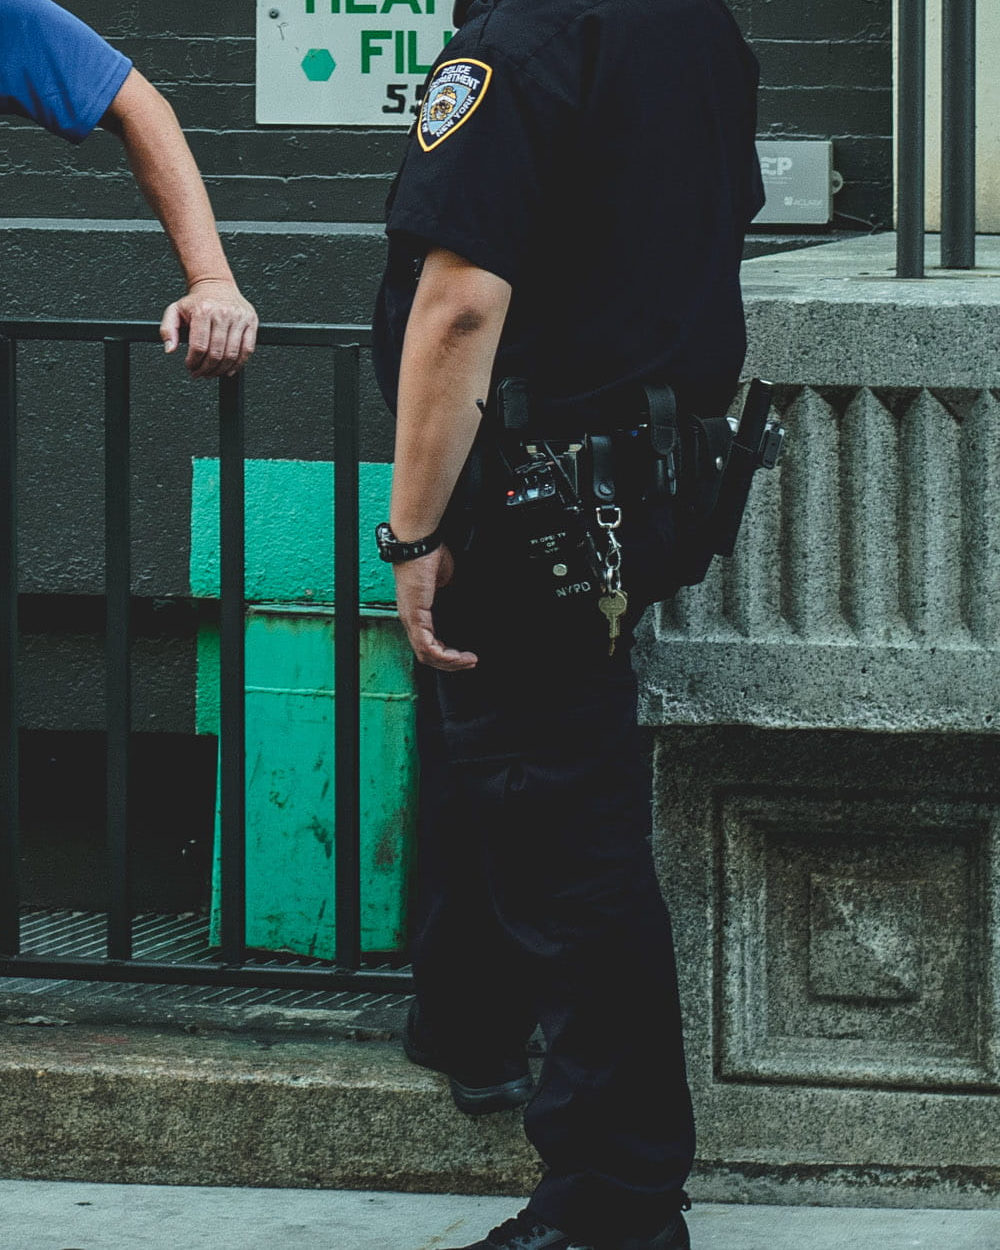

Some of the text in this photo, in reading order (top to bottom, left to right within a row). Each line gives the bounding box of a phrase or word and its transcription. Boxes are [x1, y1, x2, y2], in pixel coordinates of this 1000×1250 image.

[360, 30, 453, 74] FIL
[440, 64, 472, 76] POLICE
[429, 73, 481, 91] DEPARTMENT
[435, 95, 476, 137] NEW YORK
[555, 581, 591, 597] NYPD
